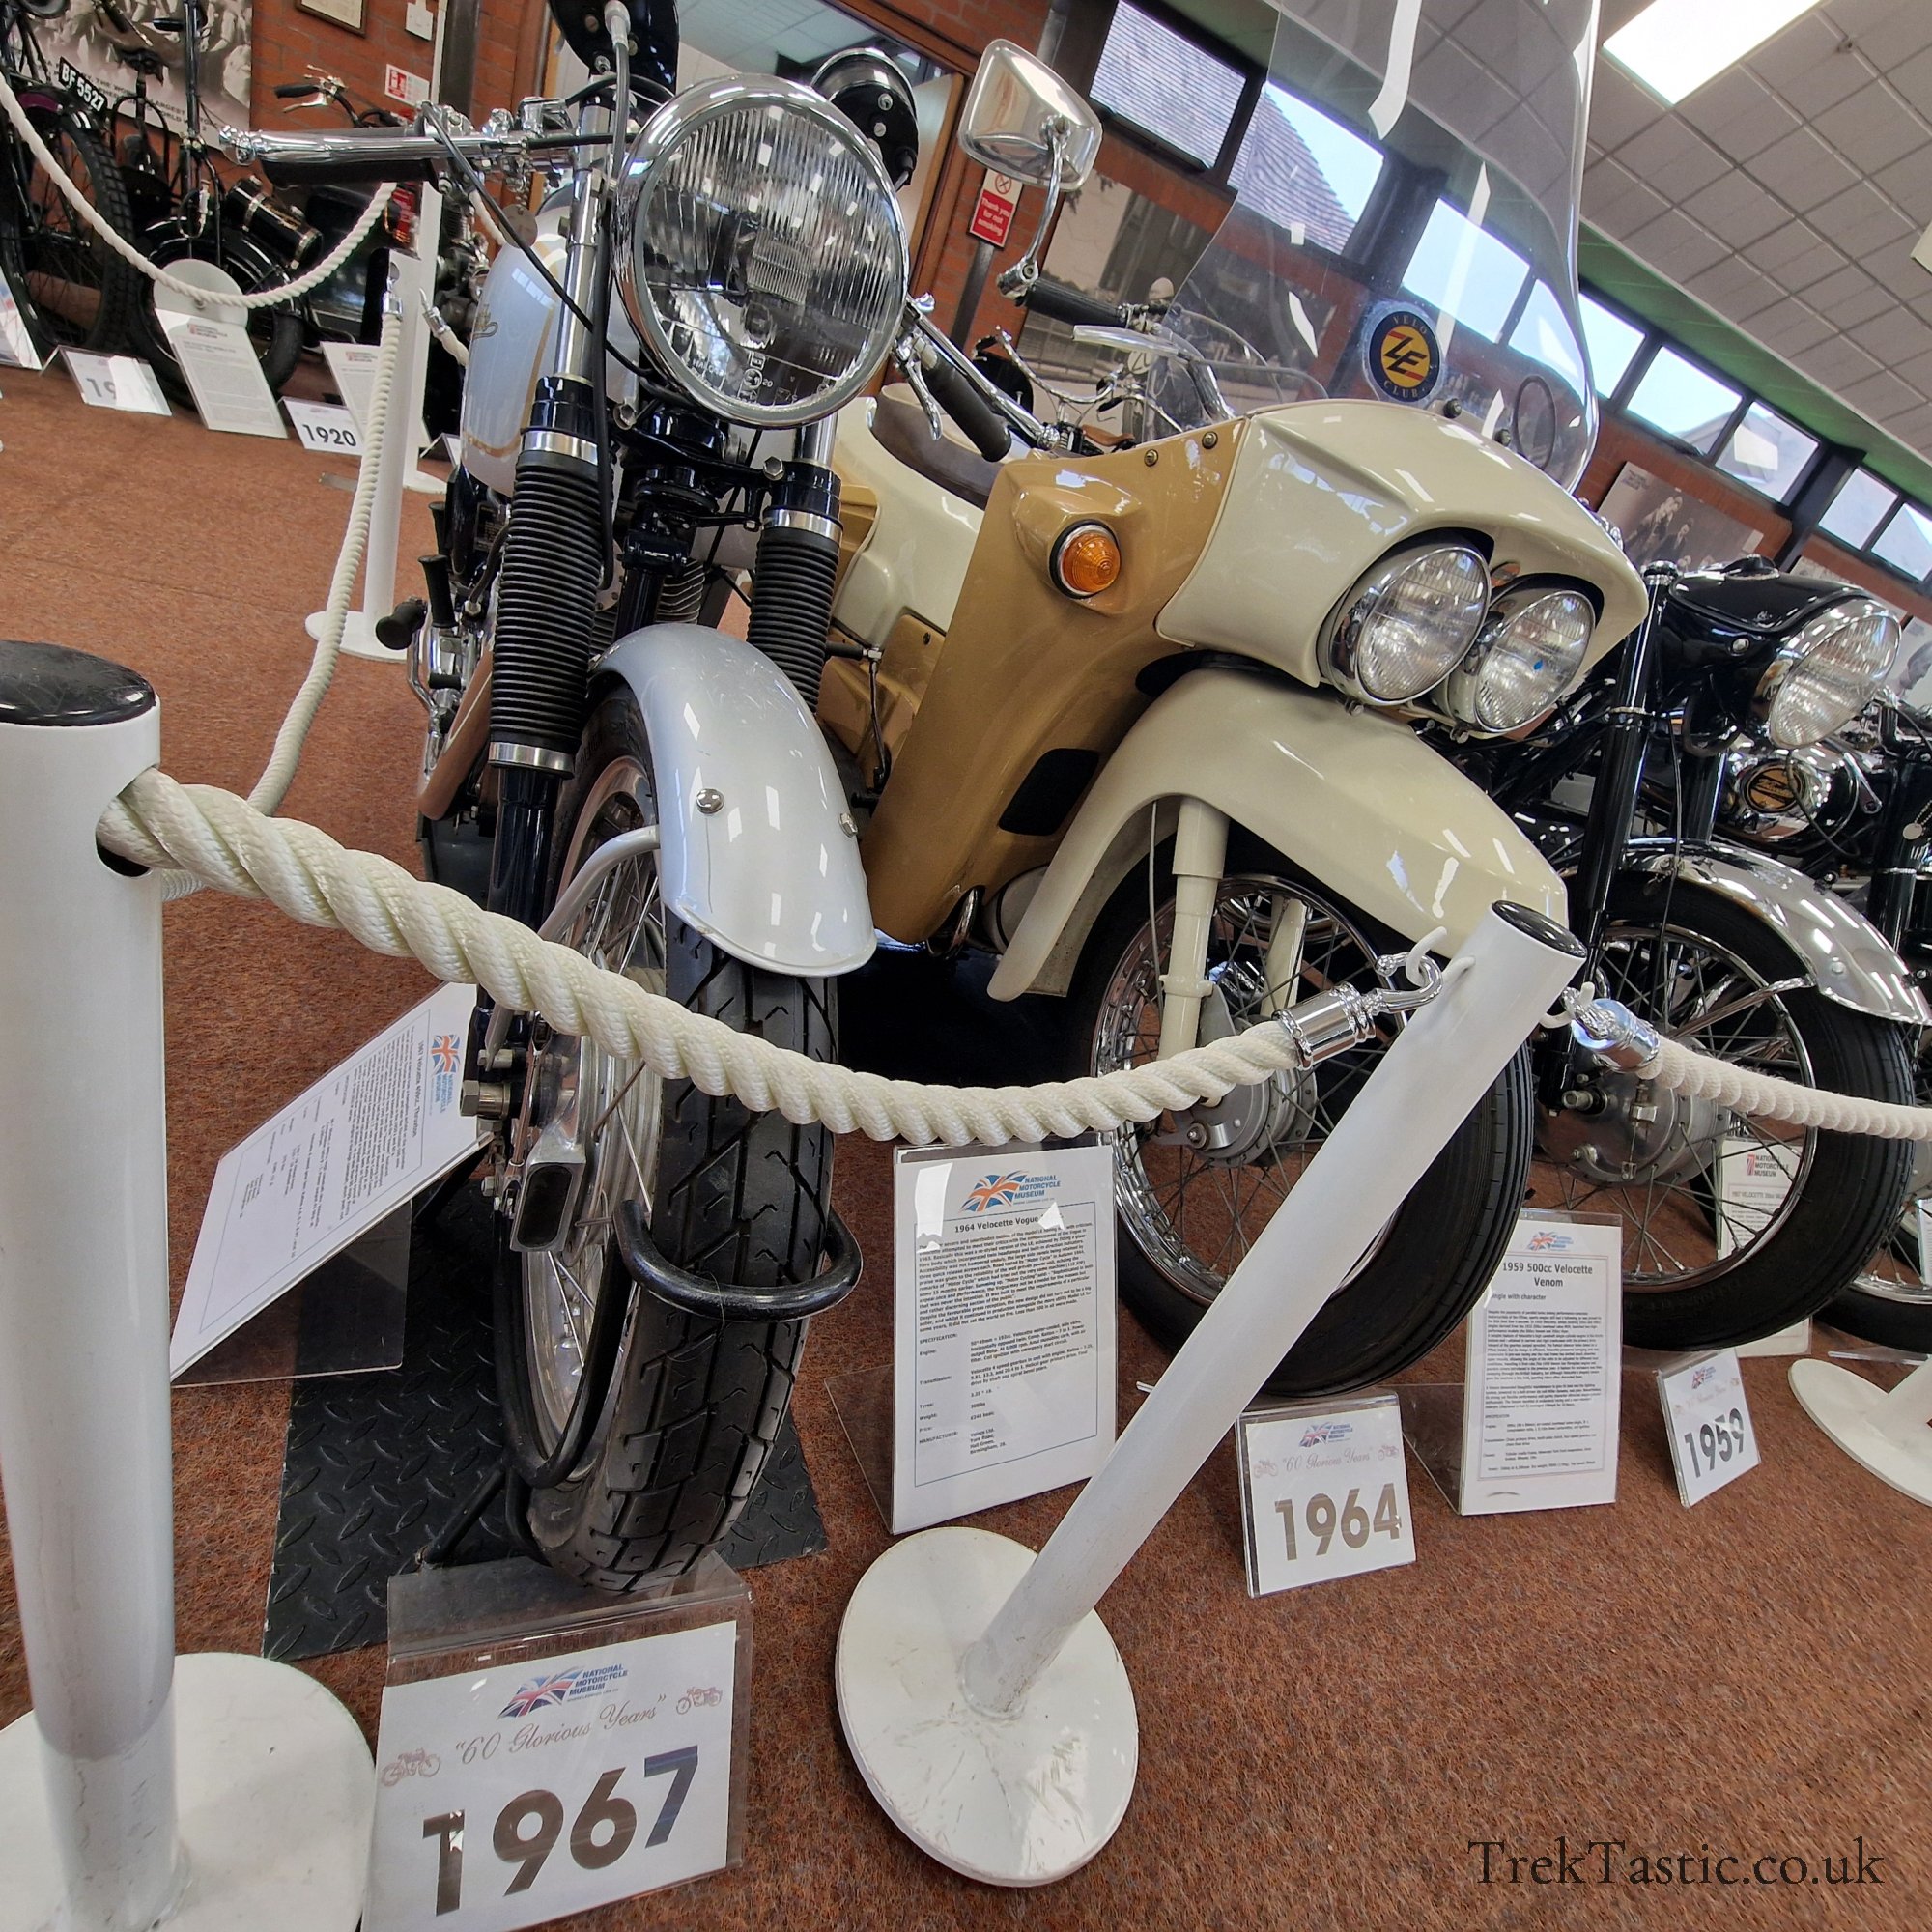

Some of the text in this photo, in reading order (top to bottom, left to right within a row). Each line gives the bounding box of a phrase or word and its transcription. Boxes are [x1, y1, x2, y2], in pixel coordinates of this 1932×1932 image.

[62, 63, 105, 111] BF 5527
[1392, 315, 1428, 334] VELO
[1383, 380, 1418, 398] CLUB
[302, 424, 356, 447] 1920
[1019, 1180, 1061, 1191] MOTORCYCLE
[1025, 1175, 1057, 1183] NATIONAL
[1014, 1190, 1045, 1199] MUSEUM
[955, 1223, 974, 1233] 1964
[977, 1218, 1013, 1230] Velocette
[1015, 1215, 1038, 1226] Vogue
[1502, 1262, 1593, 1275] 1959 500cc Velocette
[1534, 1277, 1563, 1287] Venom
[1684, 1408, 1744, 1478] 1959
[1274, 1482, 1402, 1561] 1964
[575, 1670, 628, 1687] MOTORCYCLE
[582, 1663, 624, 1679] NATIONAL
[568, 1682, 606, 1696] MUSEUM
[509, 1722, 591, 1754] Glorious
[422, 1744, 698, 1917] 1967
